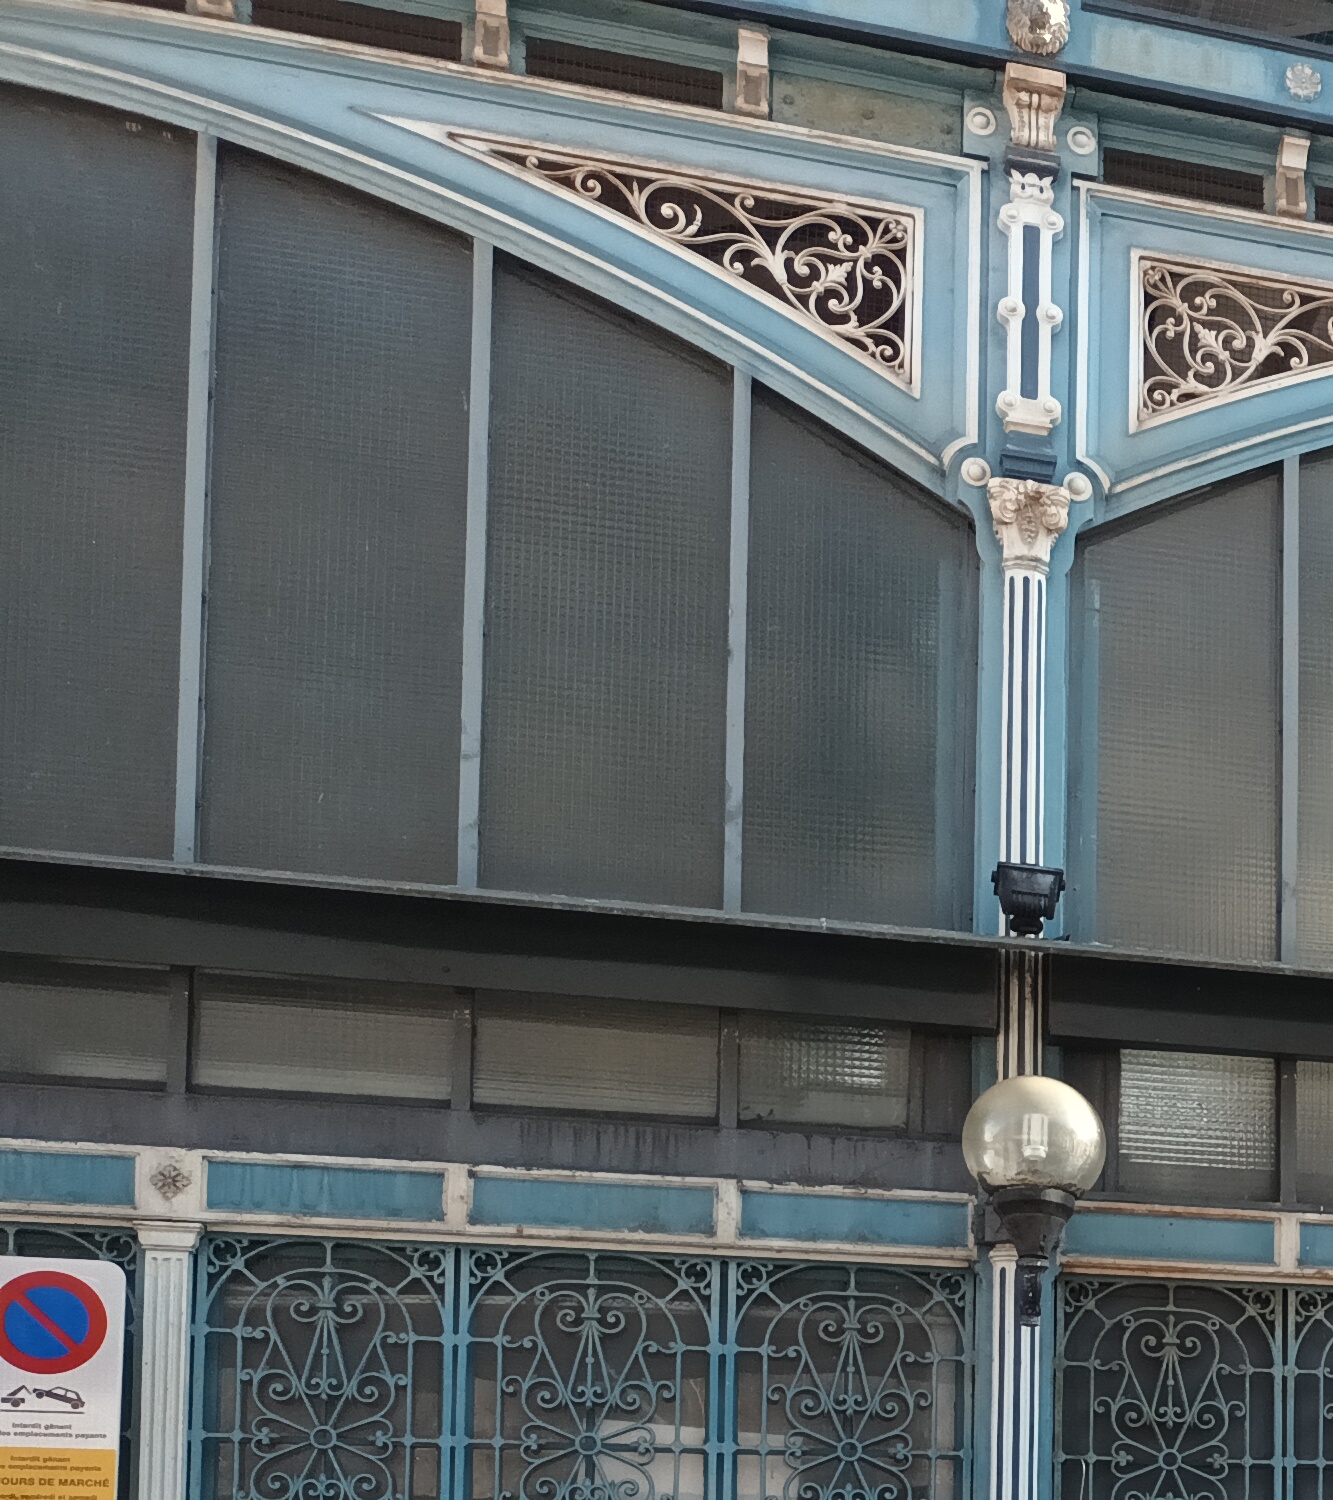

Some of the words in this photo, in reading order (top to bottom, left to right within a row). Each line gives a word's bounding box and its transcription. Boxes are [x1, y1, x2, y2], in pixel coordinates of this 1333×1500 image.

[0, 1477, 35, 1486] OURS
[39, 1478, 55, 1486] DE
[58, 1478, 110, 1487] MARCHÉ
